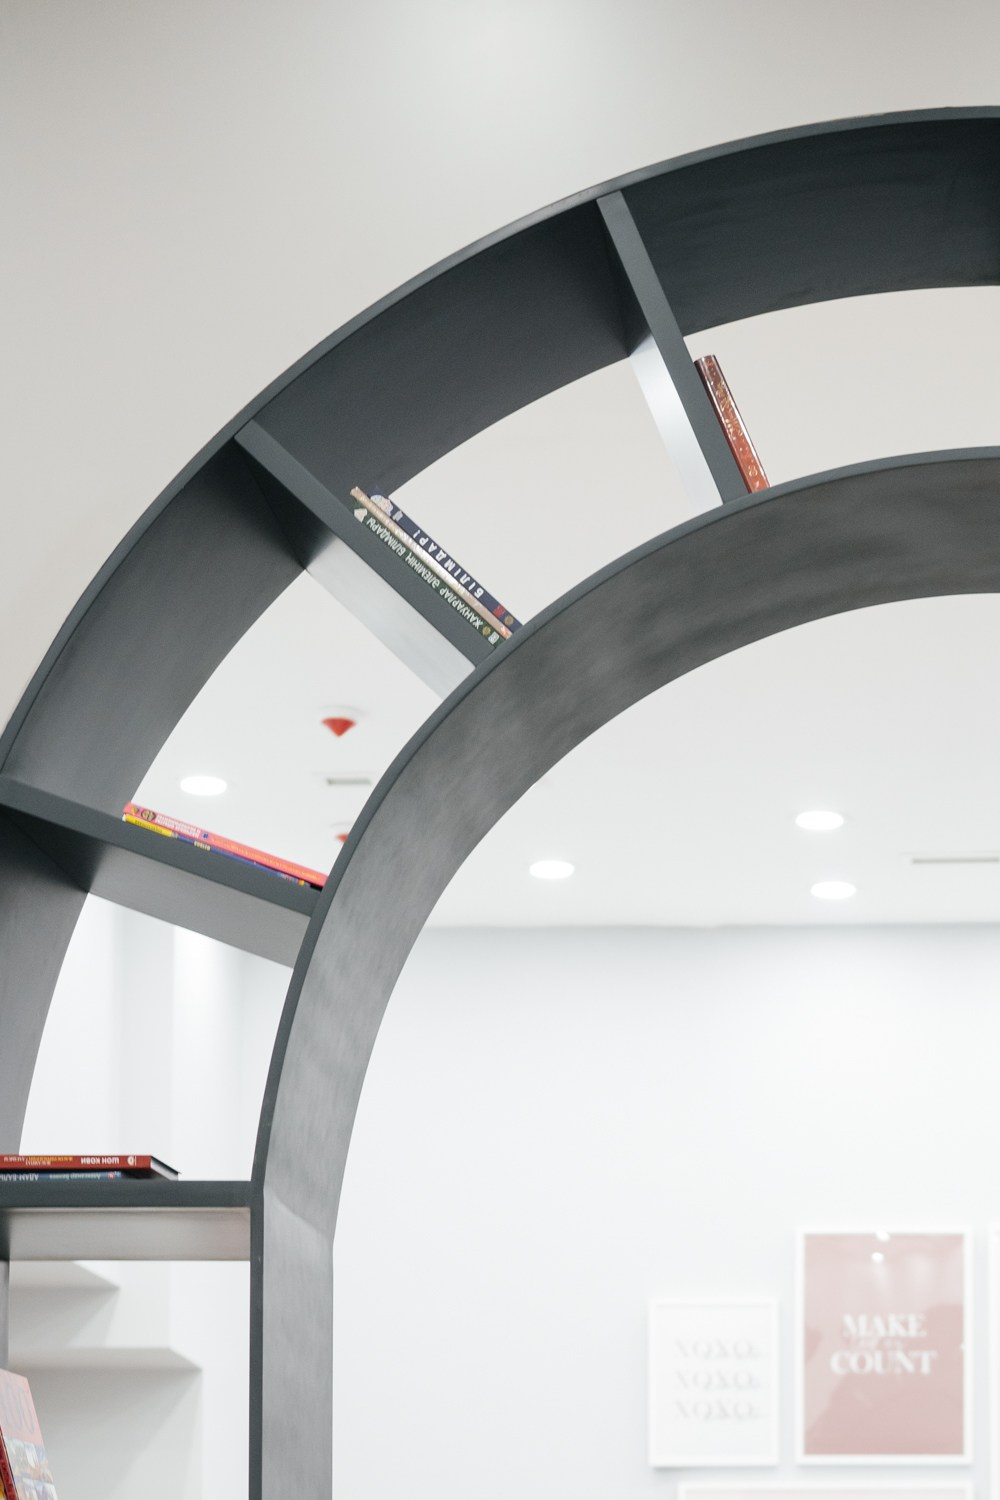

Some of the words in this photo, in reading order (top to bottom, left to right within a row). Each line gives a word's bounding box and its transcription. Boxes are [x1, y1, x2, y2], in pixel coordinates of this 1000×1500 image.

[439, 588, 484, 630] ЖАНУАРЛАР
[80, 1156, 101, 1165] КОВИ
[101, 1156, 120, 1165] ШОН
[842, 1312, 928, 1338] MAKE
[829, 1348, 939, 1376] COUNT
